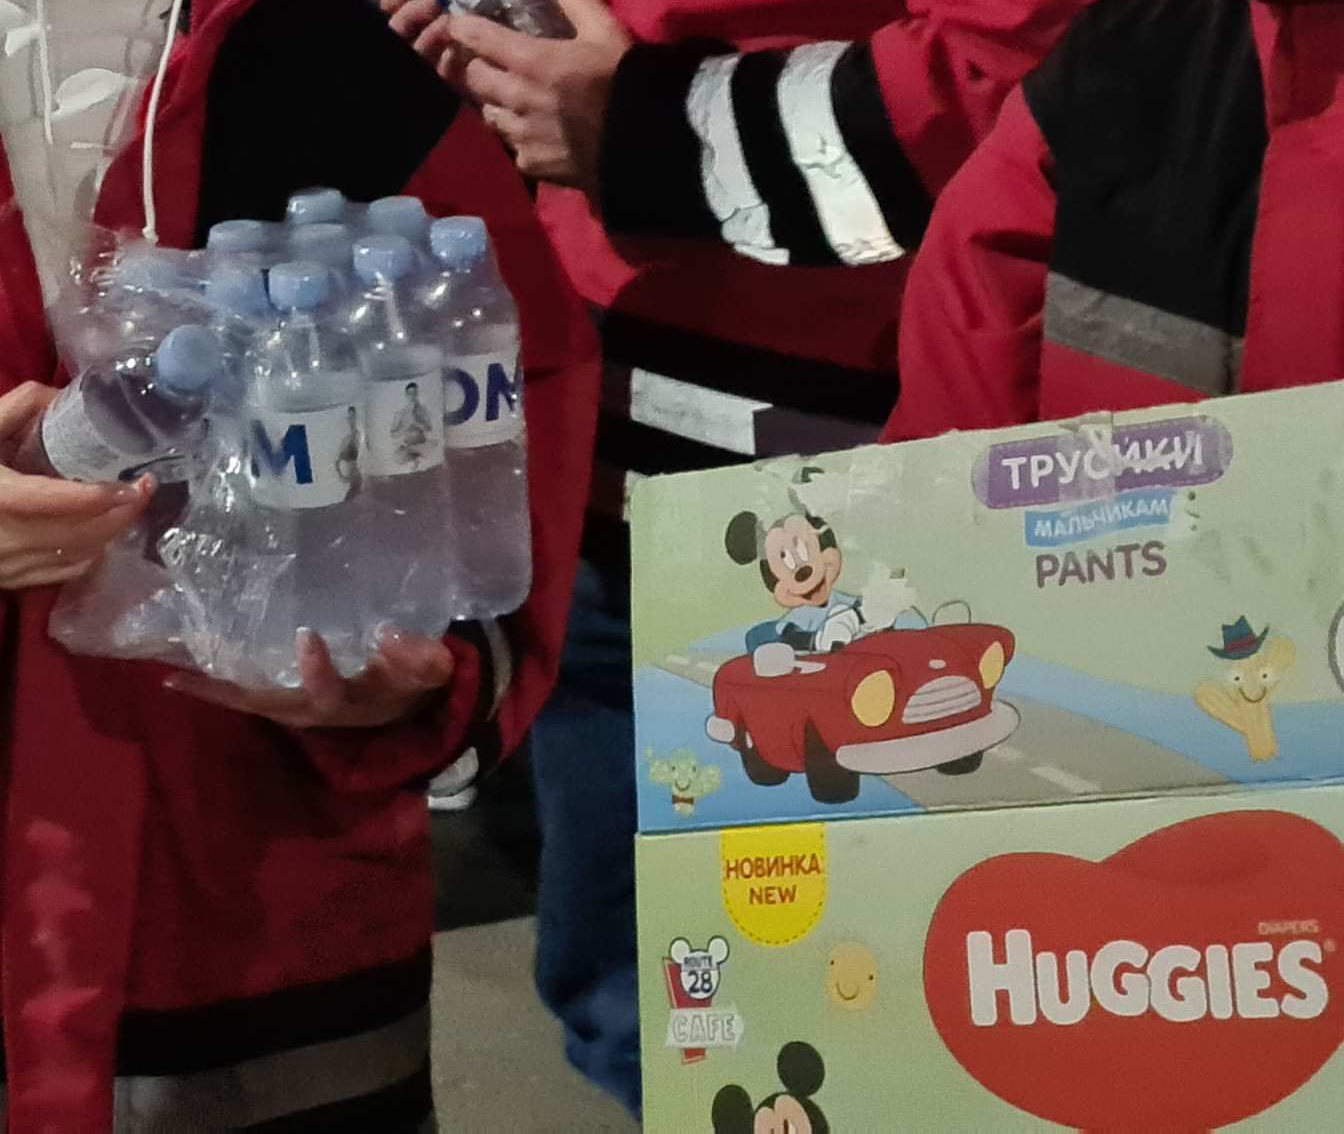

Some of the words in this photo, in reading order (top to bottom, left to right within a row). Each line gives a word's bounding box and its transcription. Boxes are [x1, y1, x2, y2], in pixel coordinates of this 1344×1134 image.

[1034, 498, 1169, 538] МАЛЬЧИКАМ
[1035, 540, 1168, 589] PANTS
[726, 853, 822, 880] НОВИНКА
[749, 885, 797, 905] NEW
[687, 970, 713, 993] 28
[671, 1013, 737, 1044] CAFE
